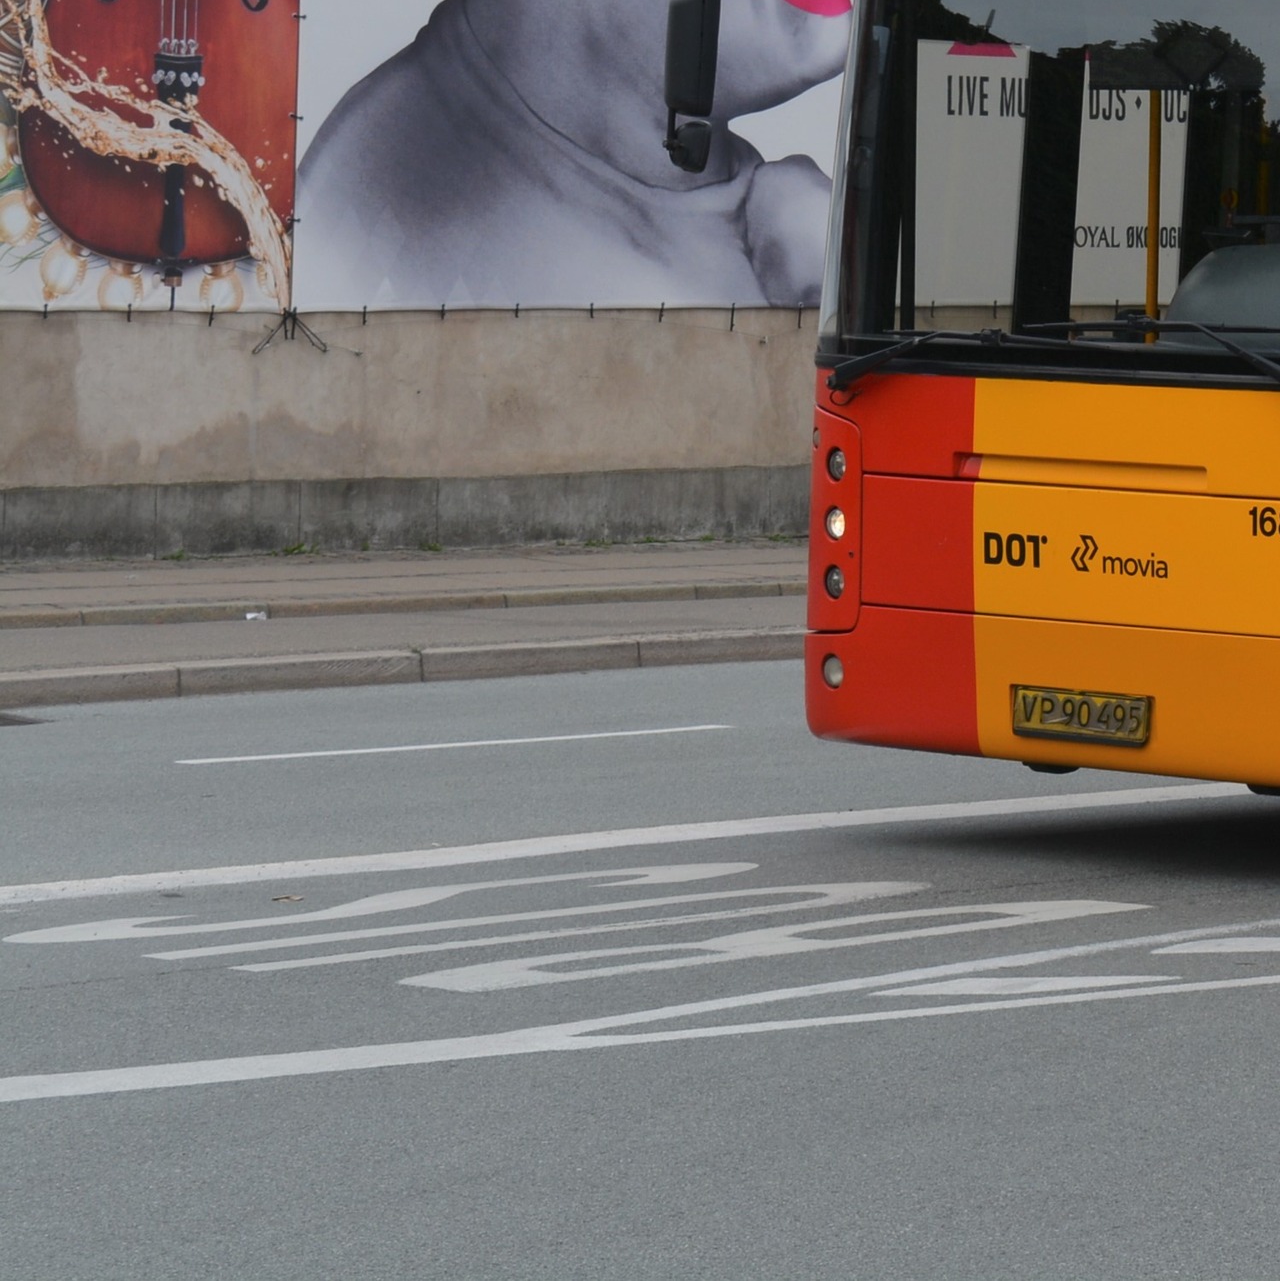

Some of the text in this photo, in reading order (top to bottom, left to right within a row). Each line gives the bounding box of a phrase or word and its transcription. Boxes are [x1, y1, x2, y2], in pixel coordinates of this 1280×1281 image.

[947, 75, 990, 116] LIVE
[1089, 89, 1126, 121] DJS
[1074, 225, 1120, 248] OYAL
[983, 531, 1048, 568] DOT
[1101, 553, 1169, 579] movia
[1022, 694, 1141, 733] VP 90 495
